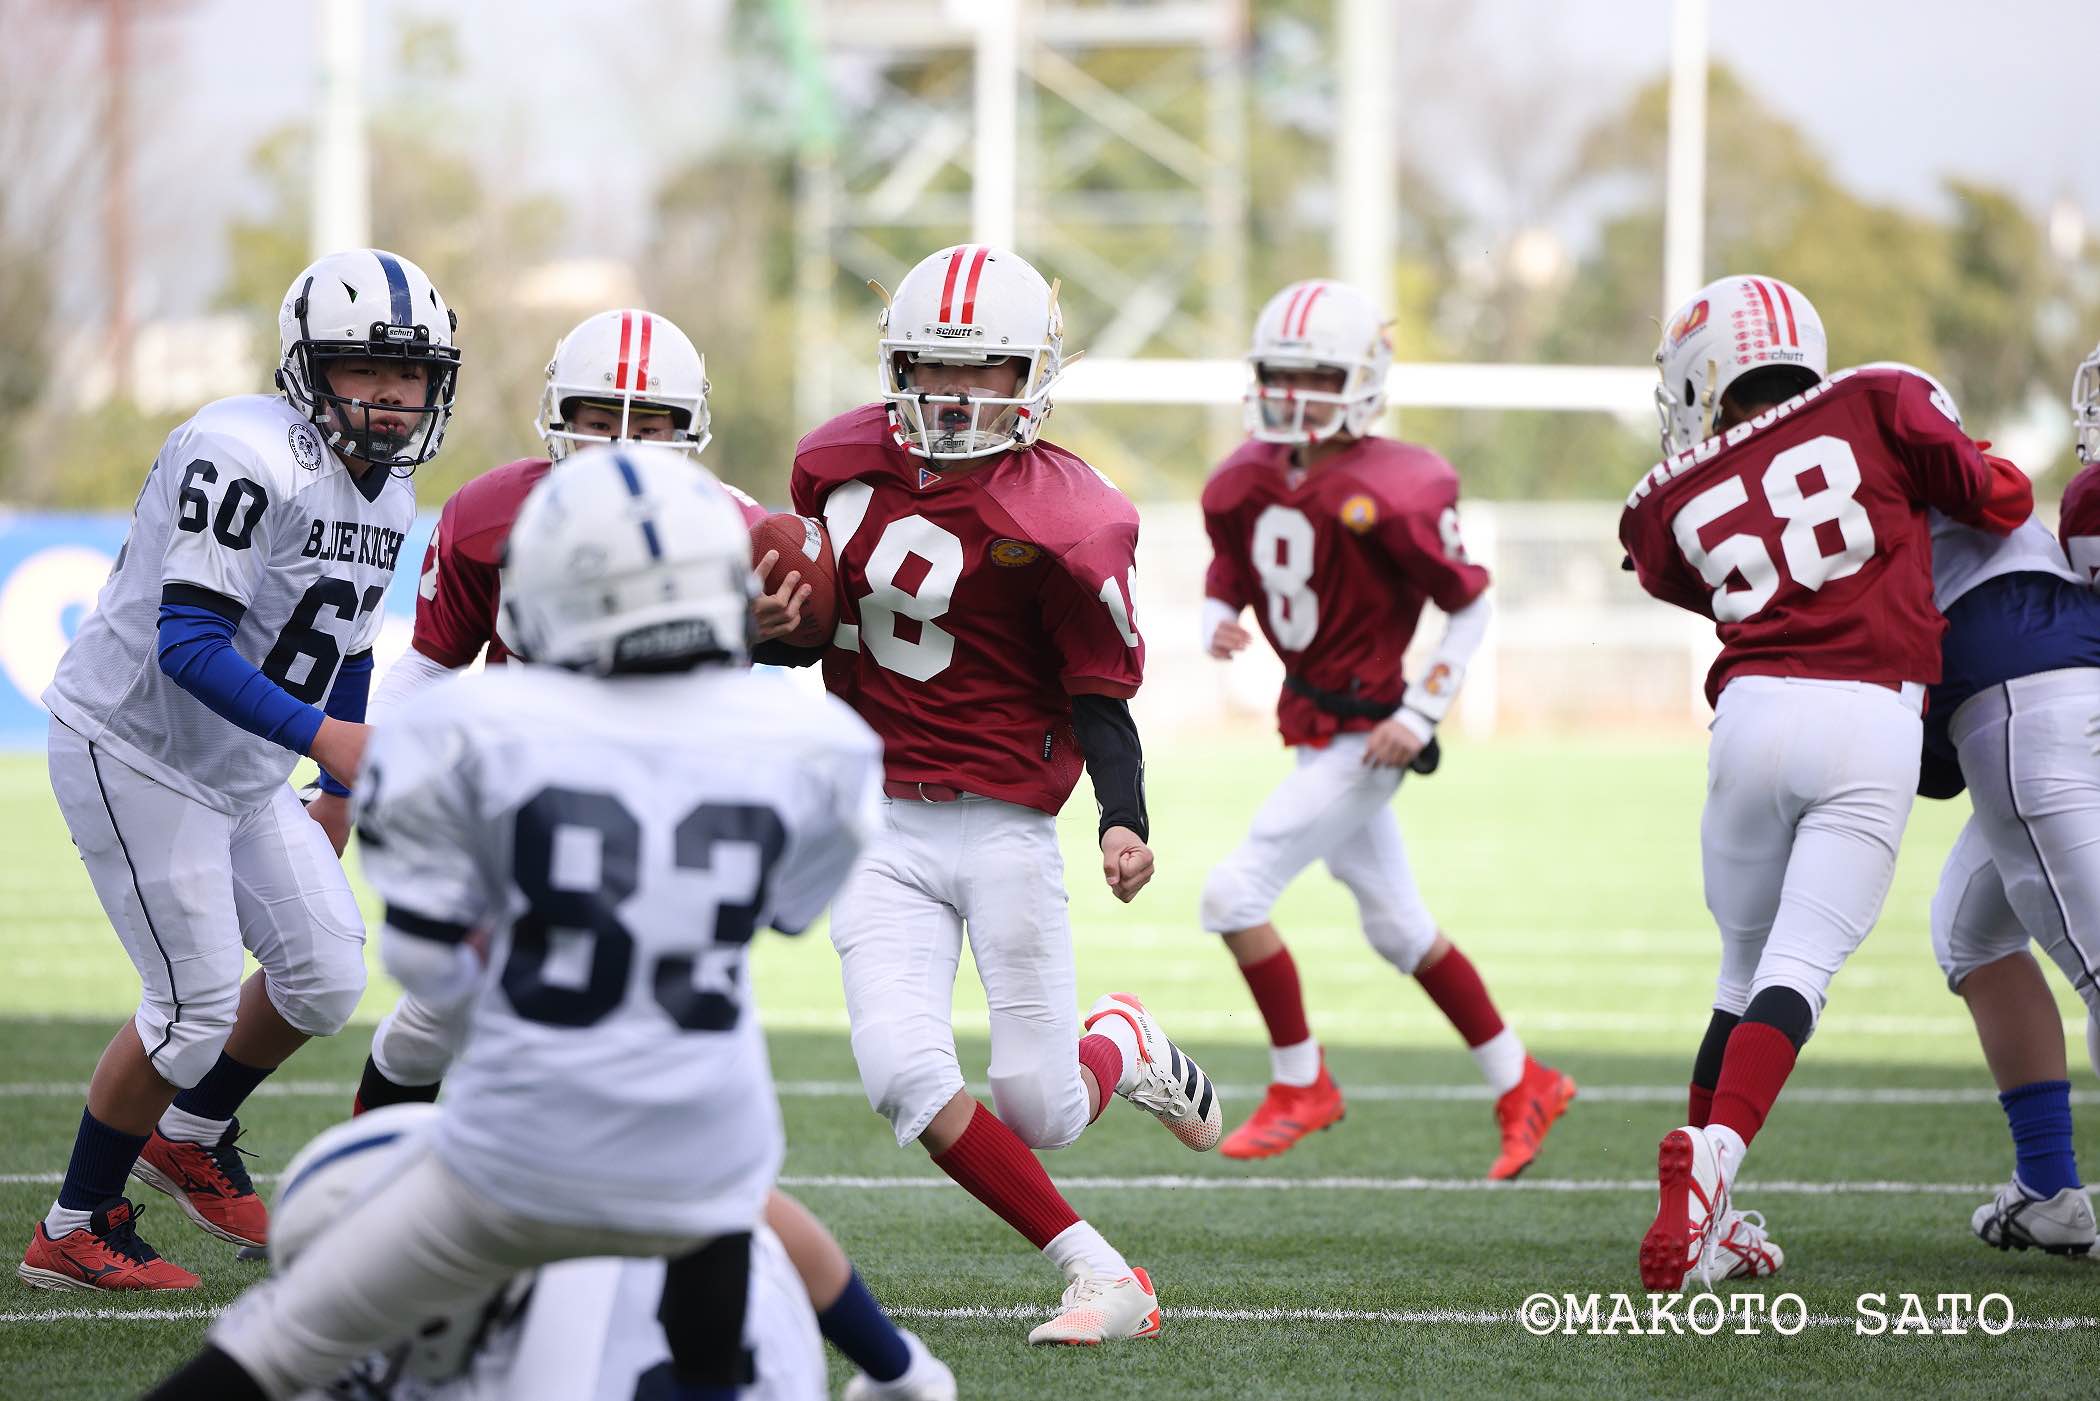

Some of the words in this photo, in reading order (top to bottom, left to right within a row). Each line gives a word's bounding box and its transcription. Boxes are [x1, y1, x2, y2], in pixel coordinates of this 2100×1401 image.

[178, 459, 269, 551] 60
[823, 479, 964, 682] 18
[1253, 504, 1319, 652] 8
[1672, 435, 1875, 623] 58
[260, 576, 384, 704] 6
[502, 784, 787, 1031] 83
